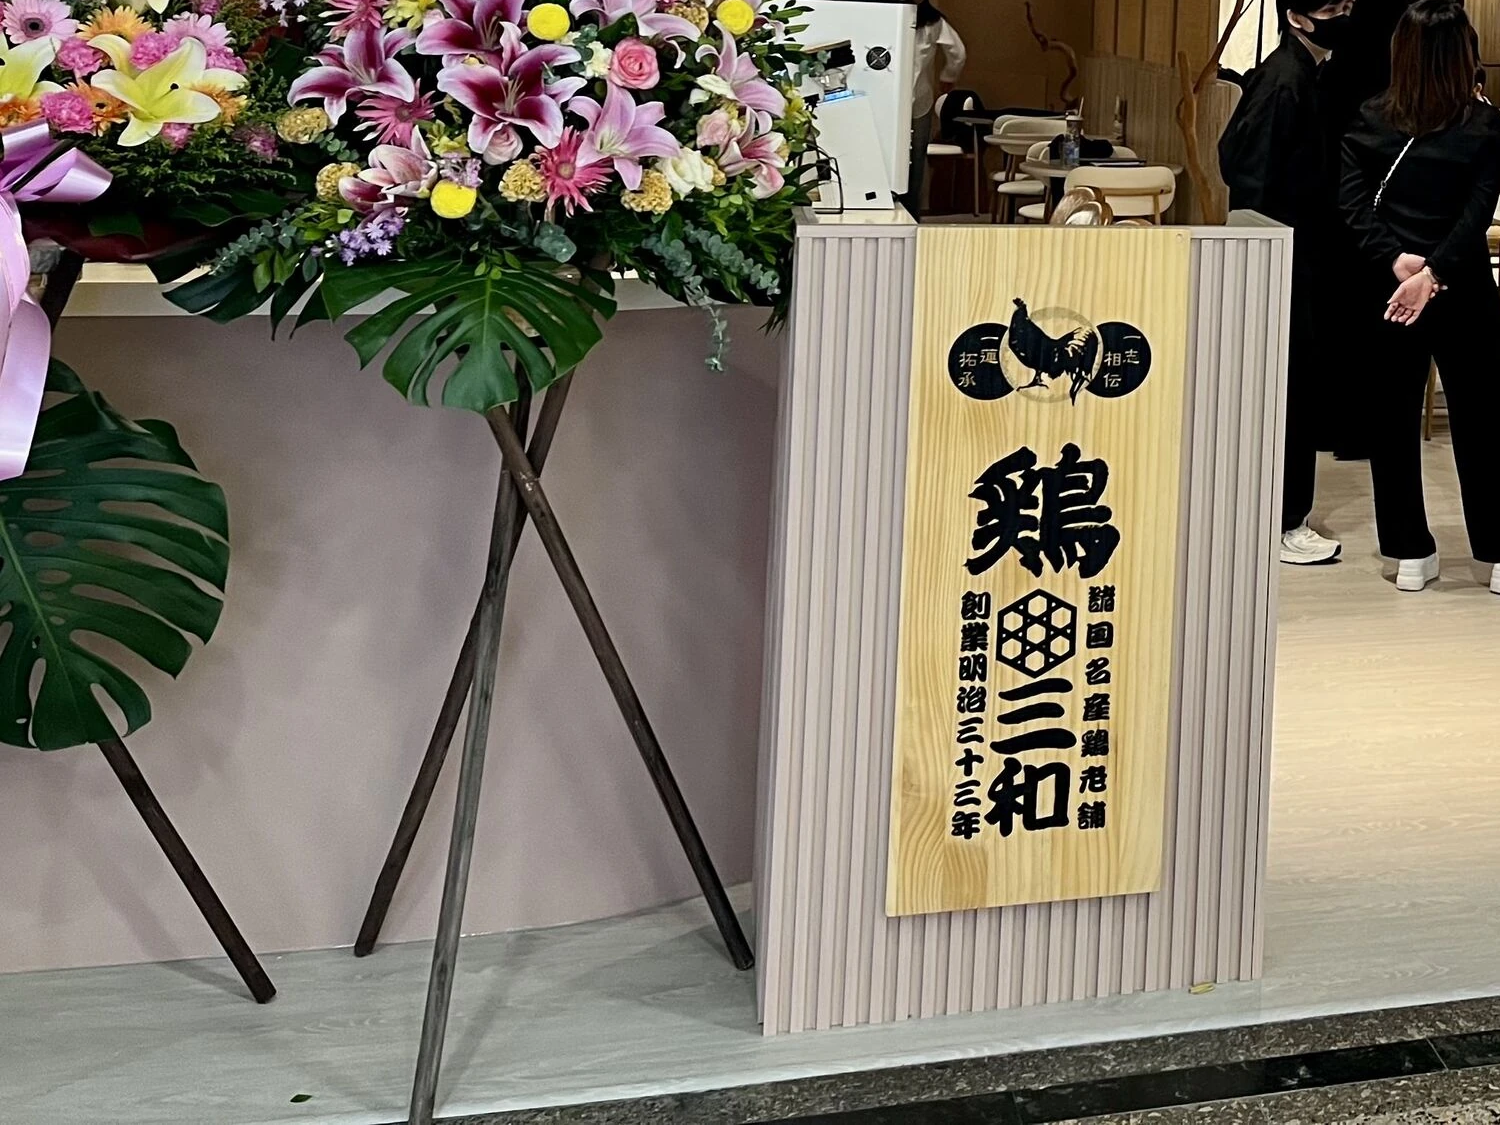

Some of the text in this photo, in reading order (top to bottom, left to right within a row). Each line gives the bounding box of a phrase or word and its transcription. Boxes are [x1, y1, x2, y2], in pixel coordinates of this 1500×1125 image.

[958, 351, 978, 388] 拓承
[1103, 351, 1122, 388] 相伝
[950, 590, 992, 841] 創業明治三十三年
[984, 678, 1078, 838] 三和
